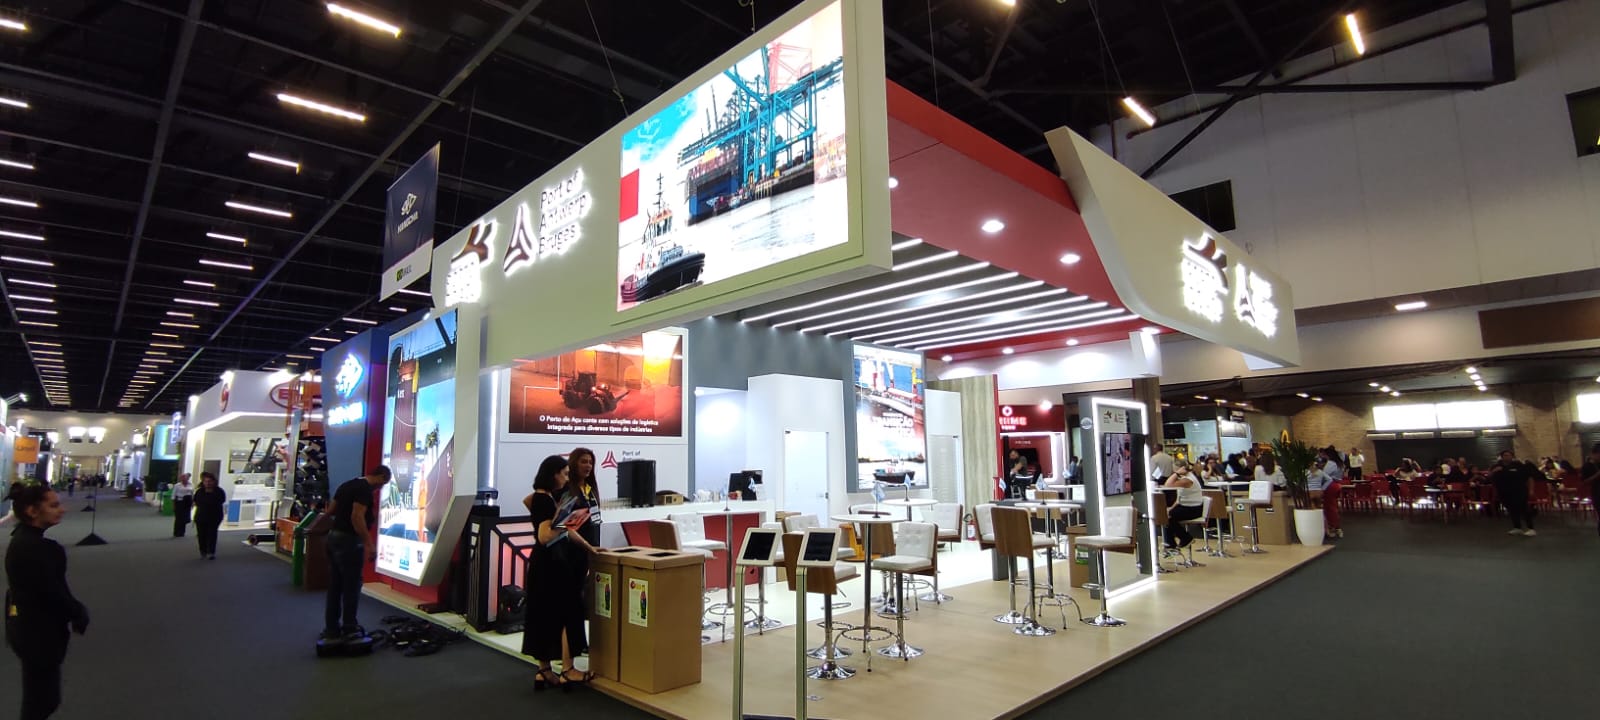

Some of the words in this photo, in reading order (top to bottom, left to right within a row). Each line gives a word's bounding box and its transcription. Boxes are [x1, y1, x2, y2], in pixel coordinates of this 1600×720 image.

[540, 182, 563, 209] Port
[566, 169, 580, 193] of
[539, 194, 587, 232] Antwerp
[538, 224, 576, 254] Bruges
